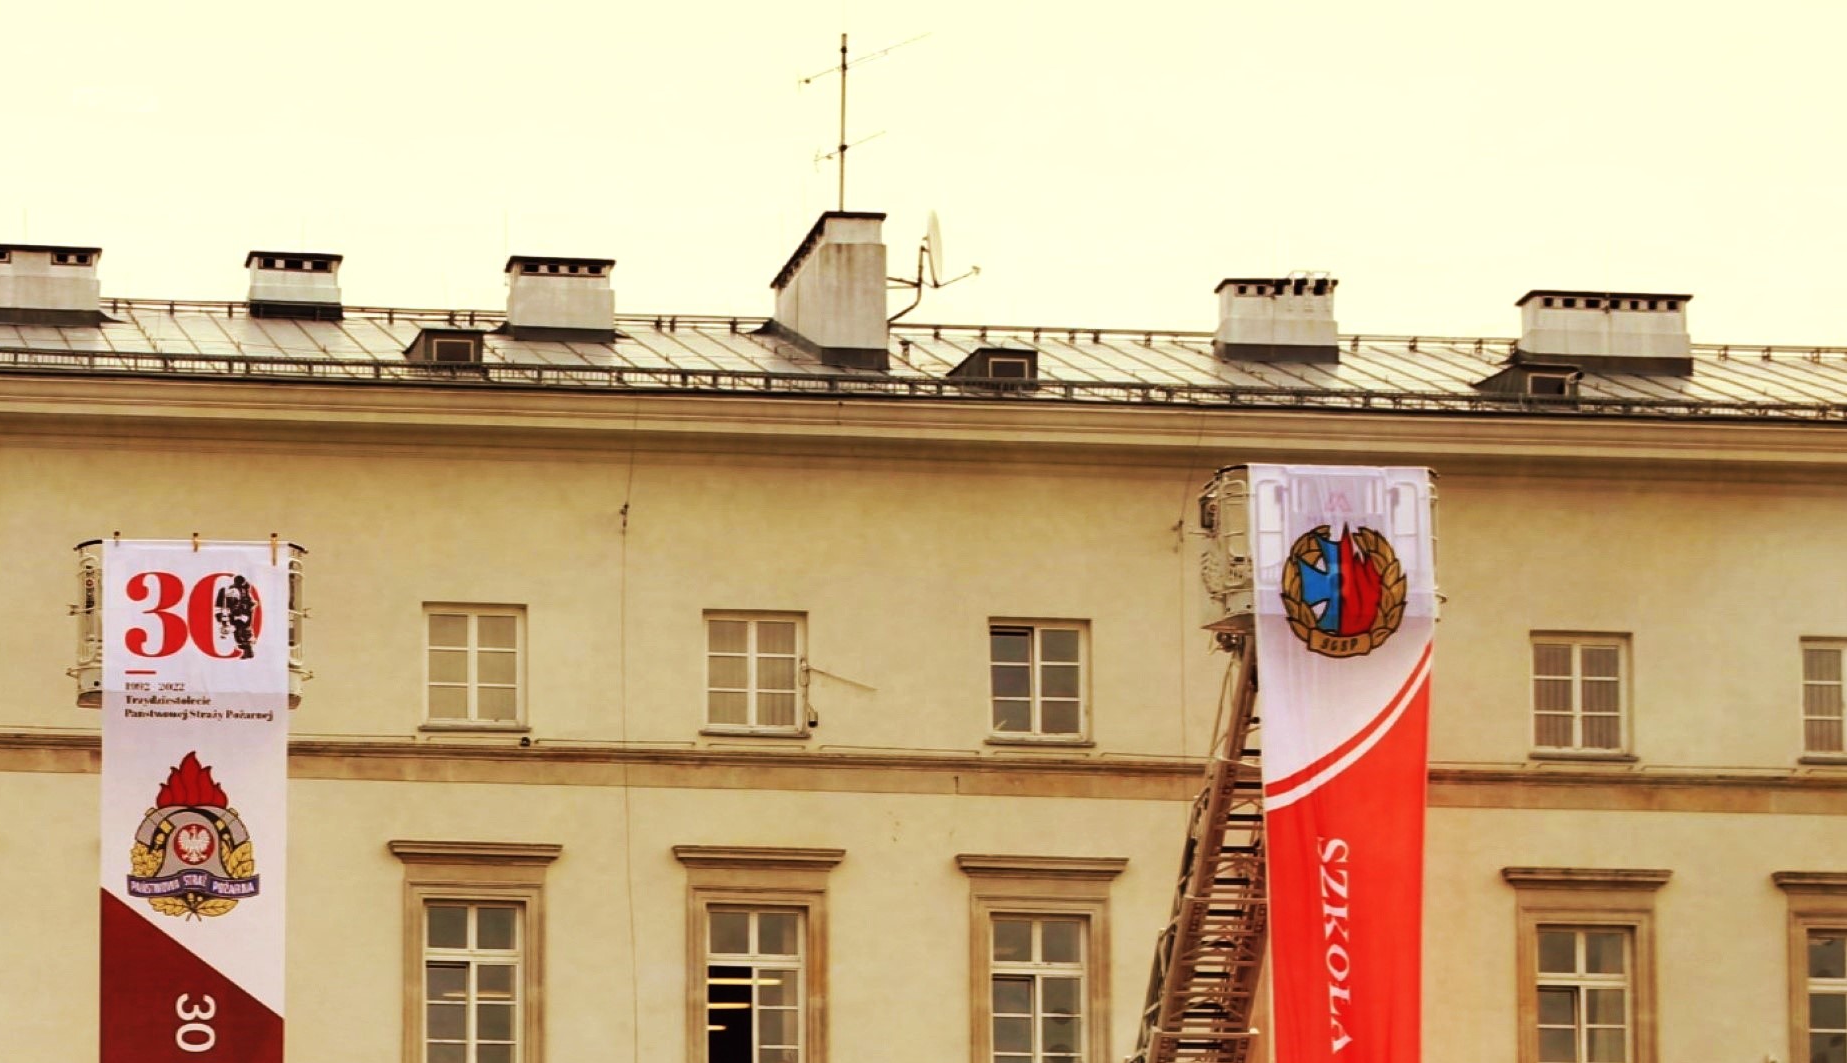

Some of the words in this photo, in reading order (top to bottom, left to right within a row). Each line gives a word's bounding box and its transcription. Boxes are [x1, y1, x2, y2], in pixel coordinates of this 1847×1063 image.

[124, 571, 263, 659] 30
[1316, 836, 1354, 1054] SZKOŁA
[174, 992, 217, 1053] 30
